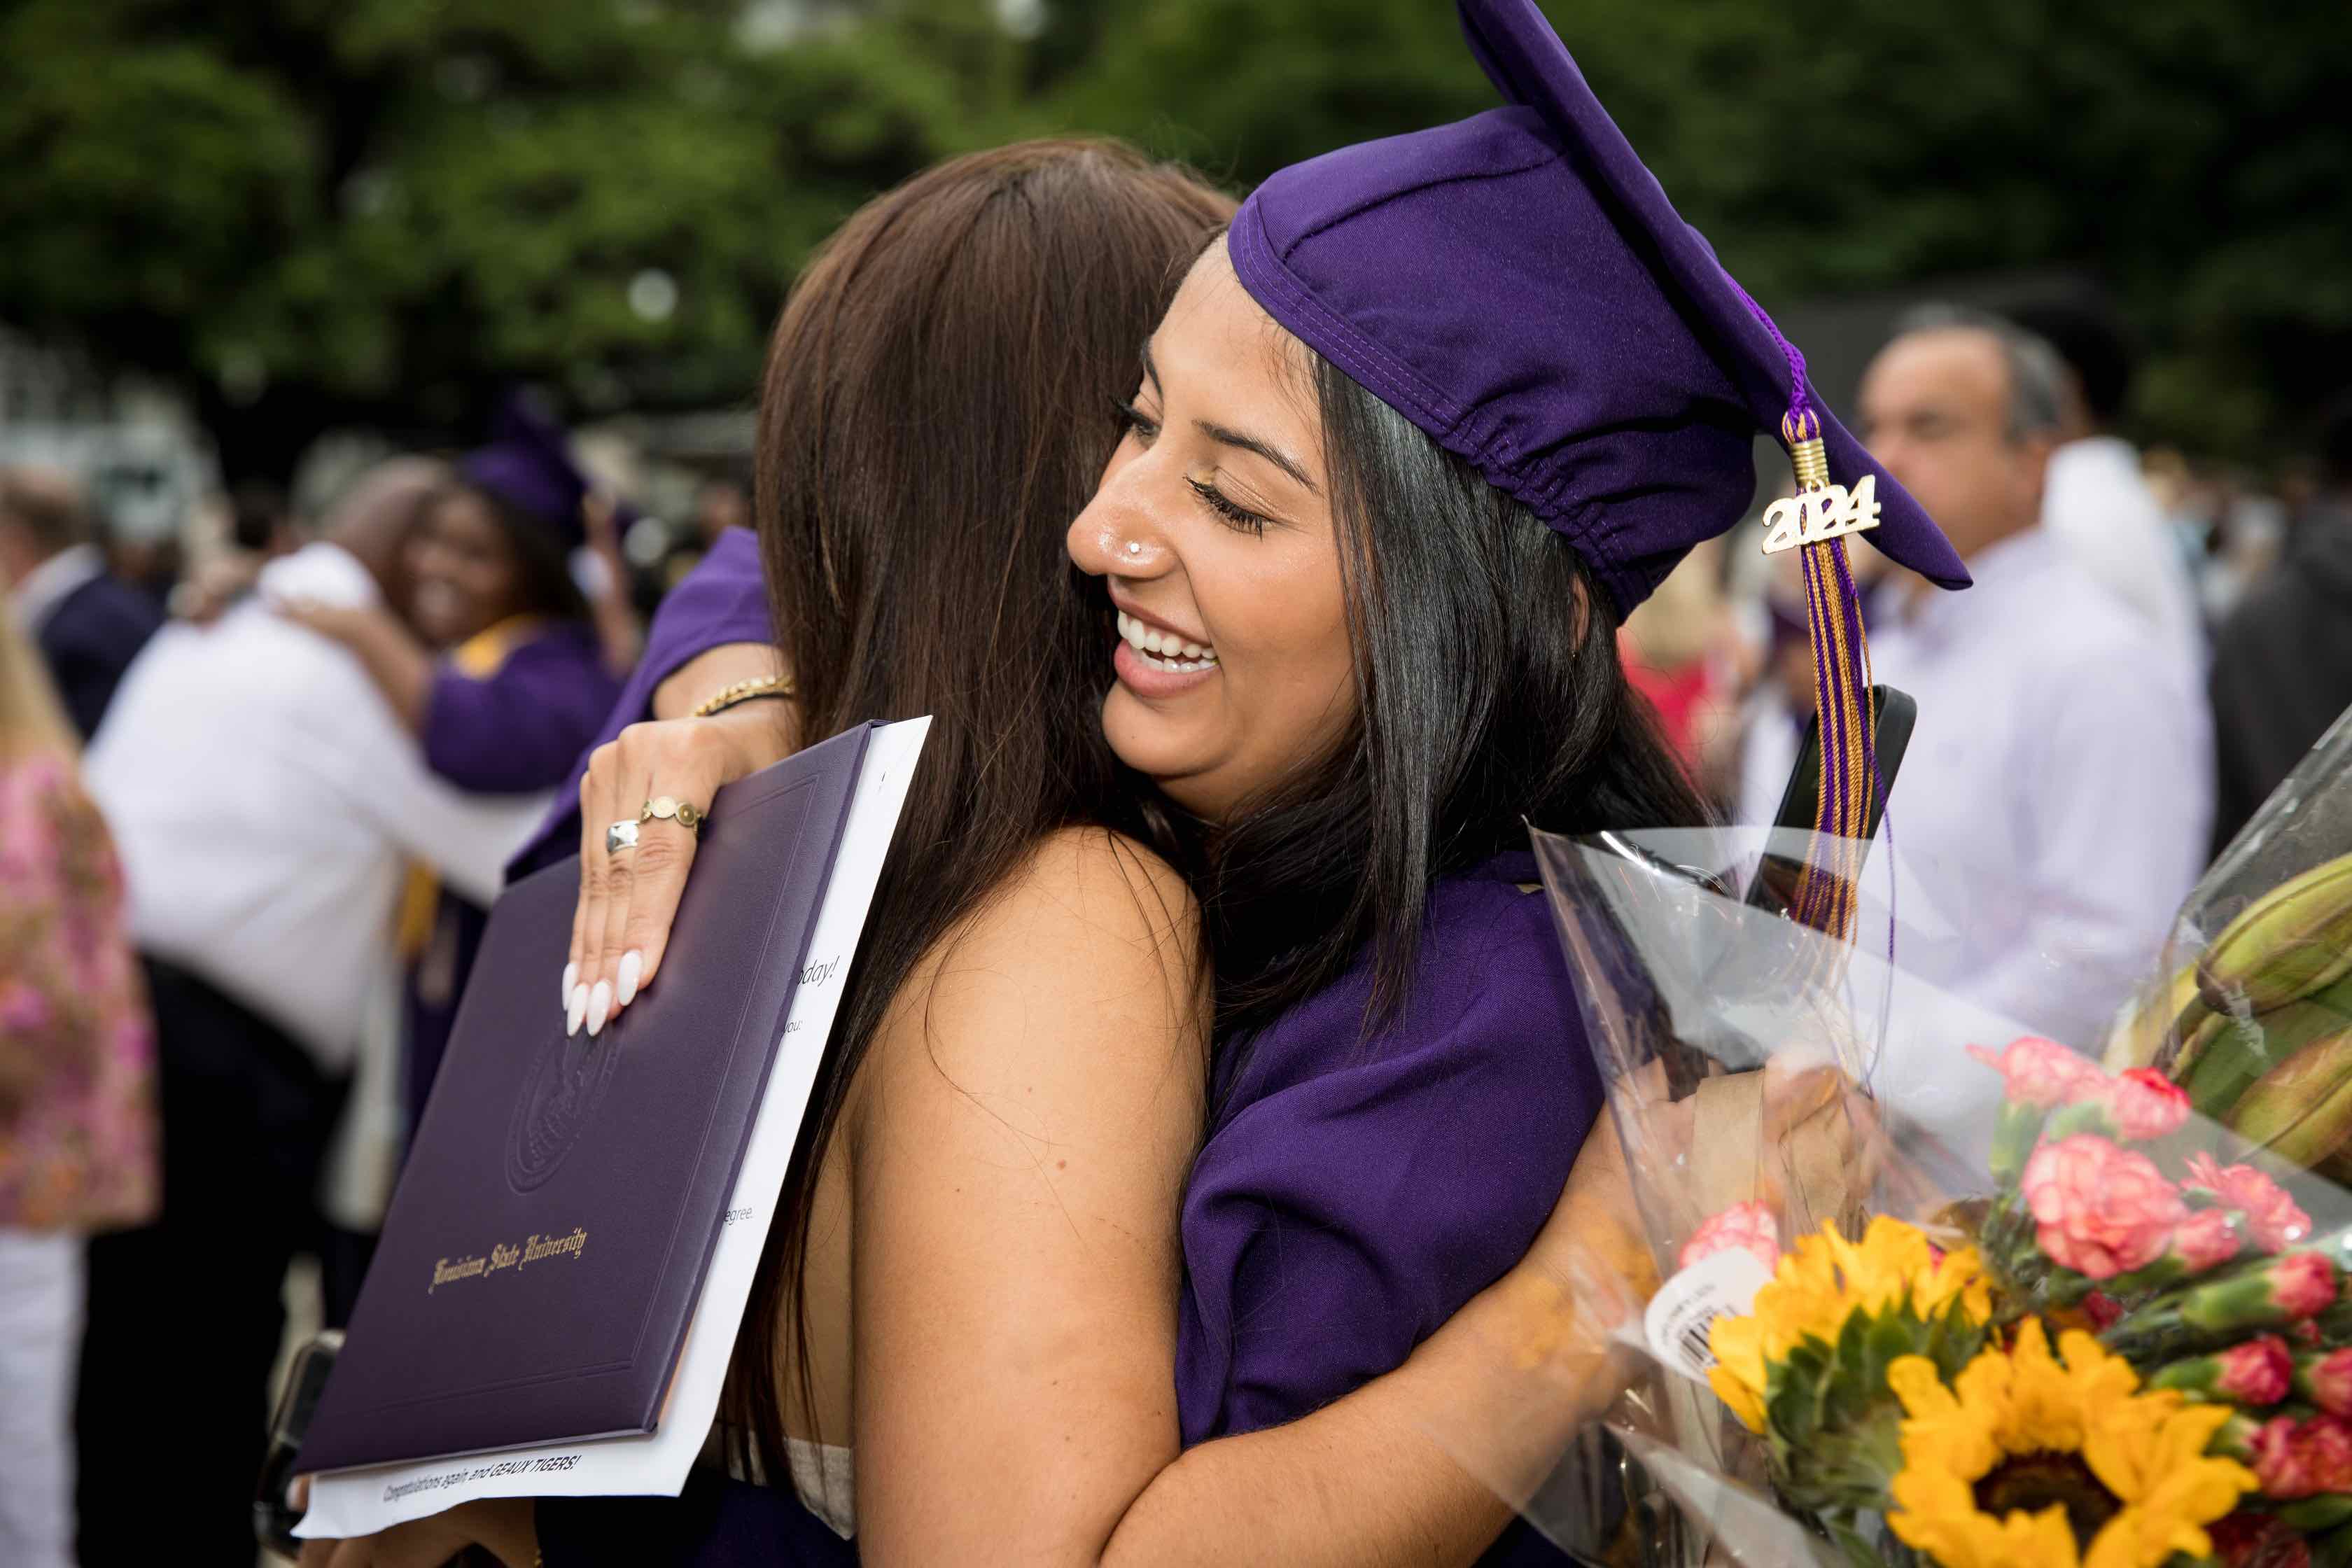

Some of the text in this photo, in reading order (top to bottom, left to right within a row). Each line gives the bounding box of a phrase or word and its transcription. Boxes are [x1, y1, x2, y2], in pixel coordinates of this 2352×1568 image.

[1762, 474, 1882, 554] 2024
[484, 1243, 519, 1278] State
[518, 1227, 587, 1270] University
[468, 1464, 494, 1480] and
[490, 1460, 533, 1478] GEAUX
[530, 1455, 582, 1472] TIGERS!
